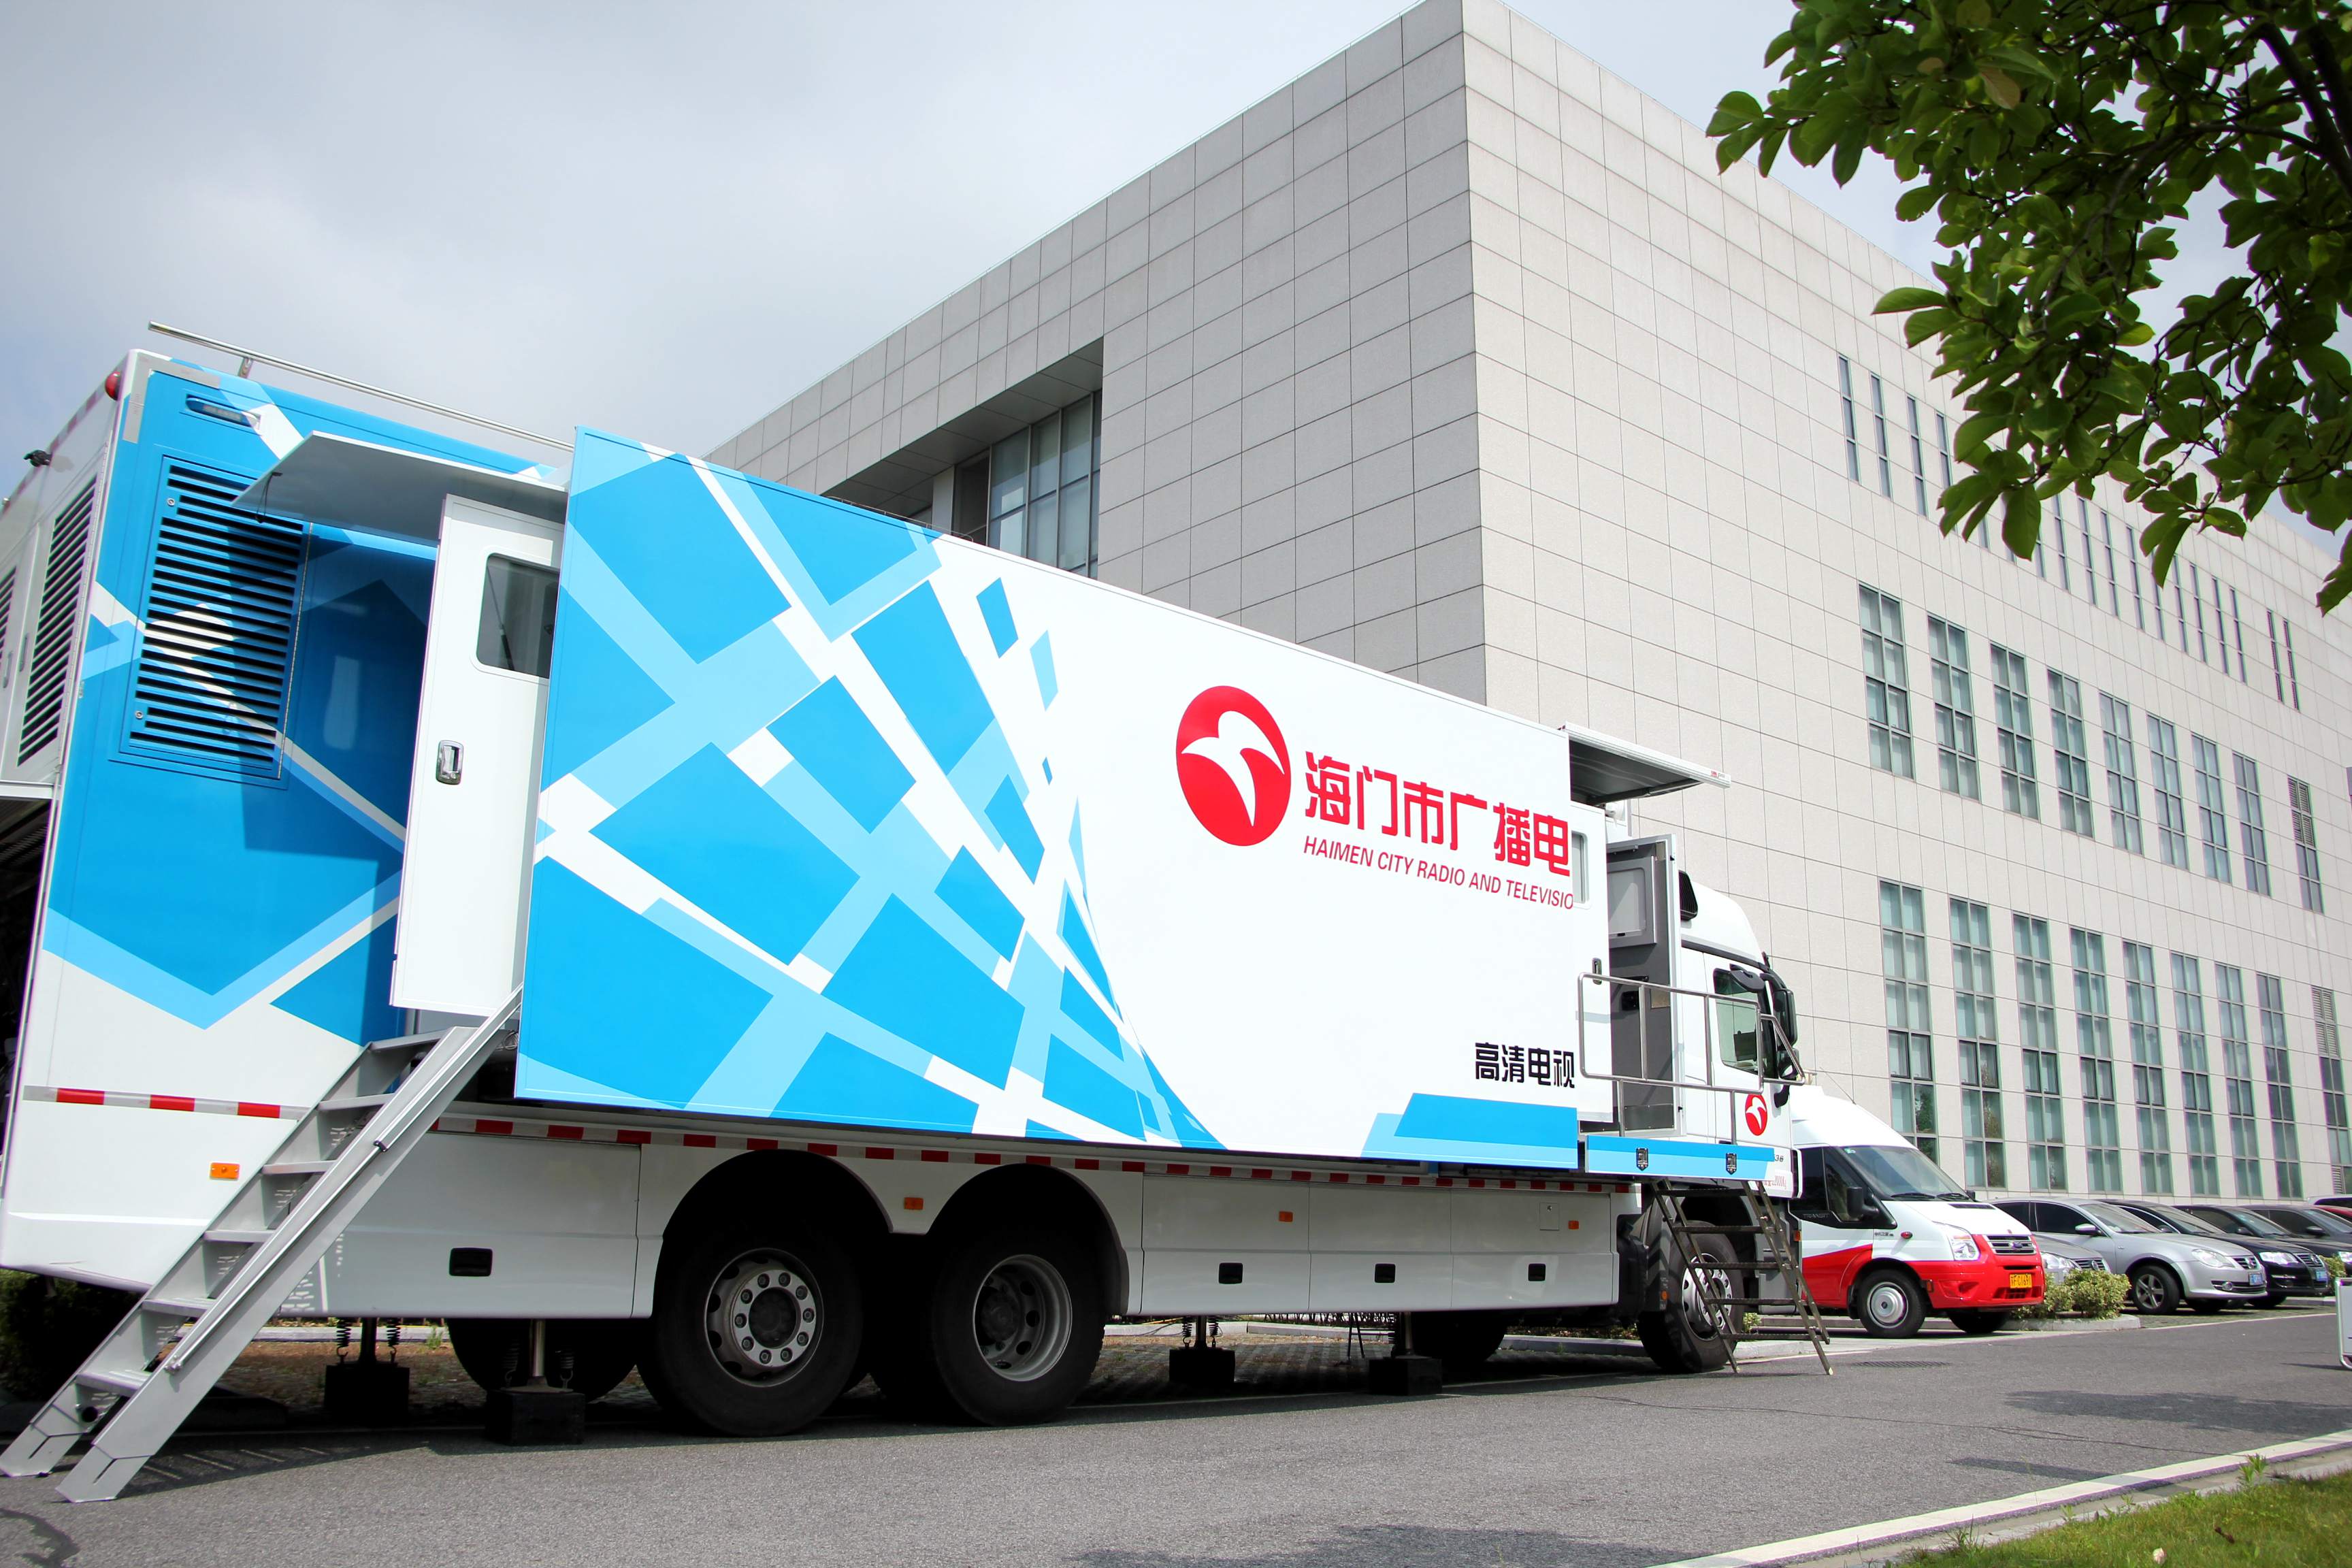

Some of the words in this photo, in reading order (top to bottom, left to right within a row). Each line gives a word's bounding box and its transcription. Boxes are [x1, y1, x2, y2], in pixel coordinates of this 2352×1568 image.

[1305, 751, 1571, 877] 海门市广播电
[1303, 836, 1374, 868] HAIMEN
[1377, 851, 1414, 875] CITY
[1417, 860, 1465, 886] RADIO
[1469, 872, 1501, 894] AND
[1506, 879, 1575, 910] TELEVISIO
[1475, 1042, 1575, 1089] 高清电视
